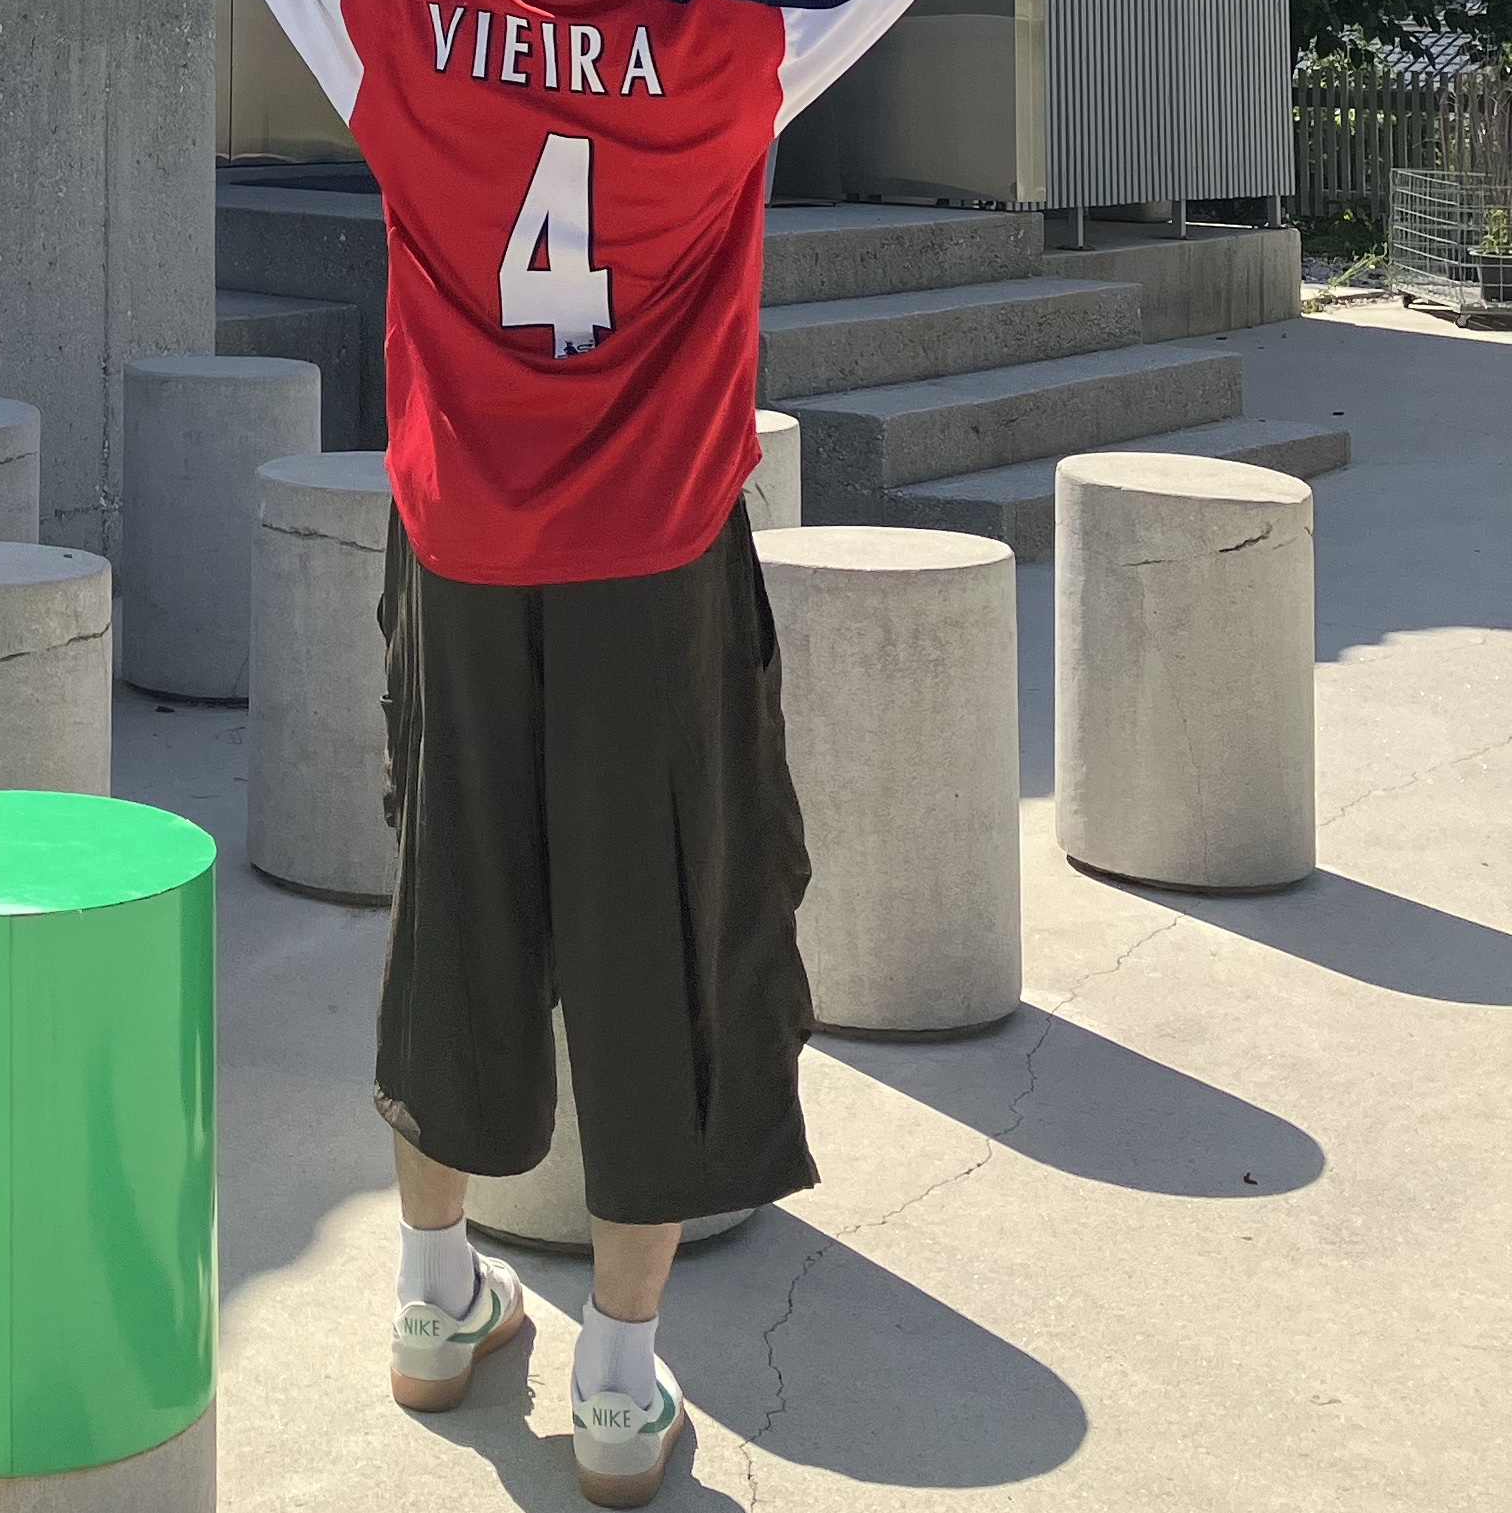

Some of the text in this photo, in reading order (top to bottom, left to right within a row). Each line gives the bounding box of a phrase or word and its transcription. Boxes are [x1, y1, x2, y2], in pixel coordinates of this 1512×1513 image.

[427, 2, 663, 96] VIEIRA
[499, 132, 612, 360] 4
[404, 1316, 440, 1337] NIKE
[593, 1406, 631, 1428] NIKE
